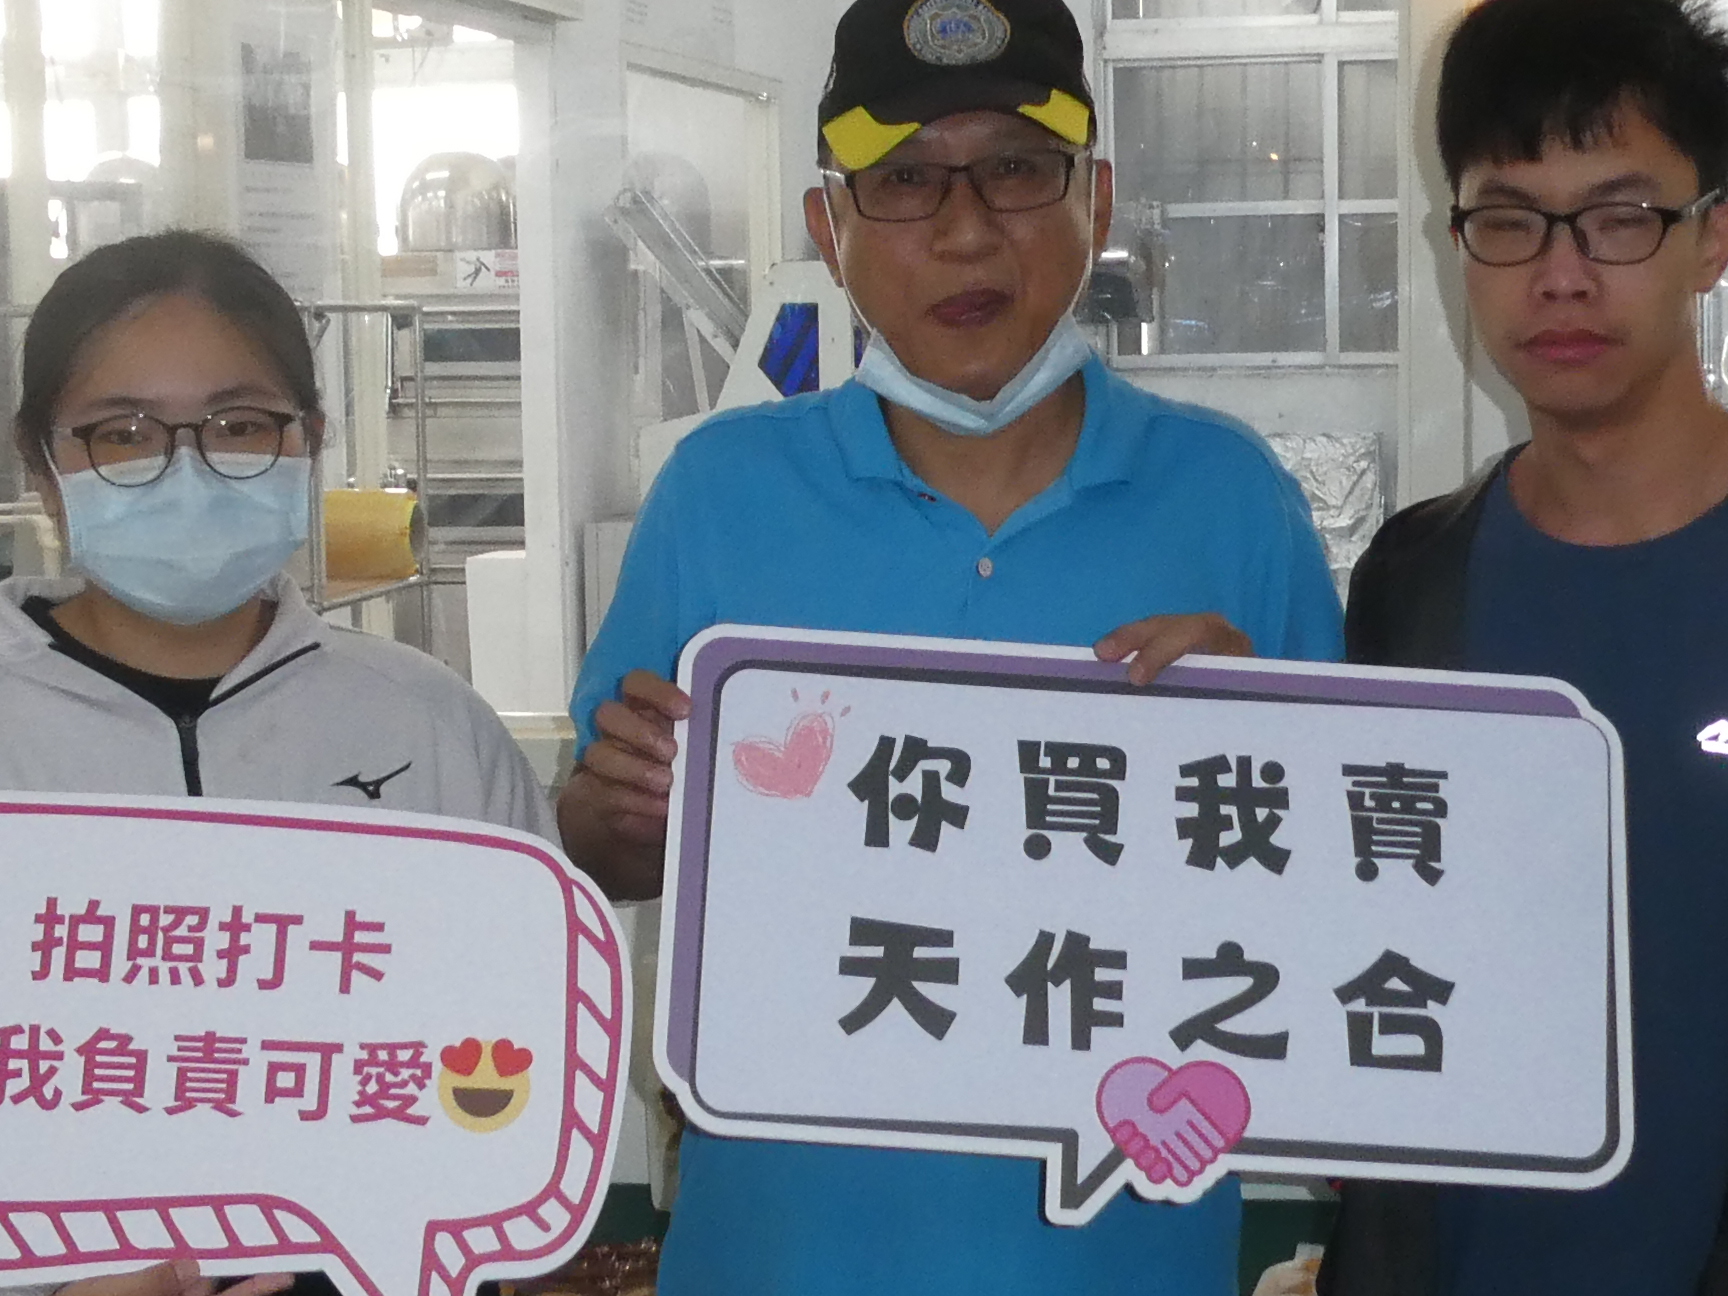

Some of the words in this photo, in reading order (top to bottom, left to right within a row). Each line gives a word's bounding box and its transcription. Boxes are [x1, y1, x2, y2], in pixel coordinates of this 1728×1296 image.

[846, 733, 1449, 887] 你買我賣
[31, 896, 392, 995] 拍照打卡
[836, 915, 1456, 1074] 天作之合
